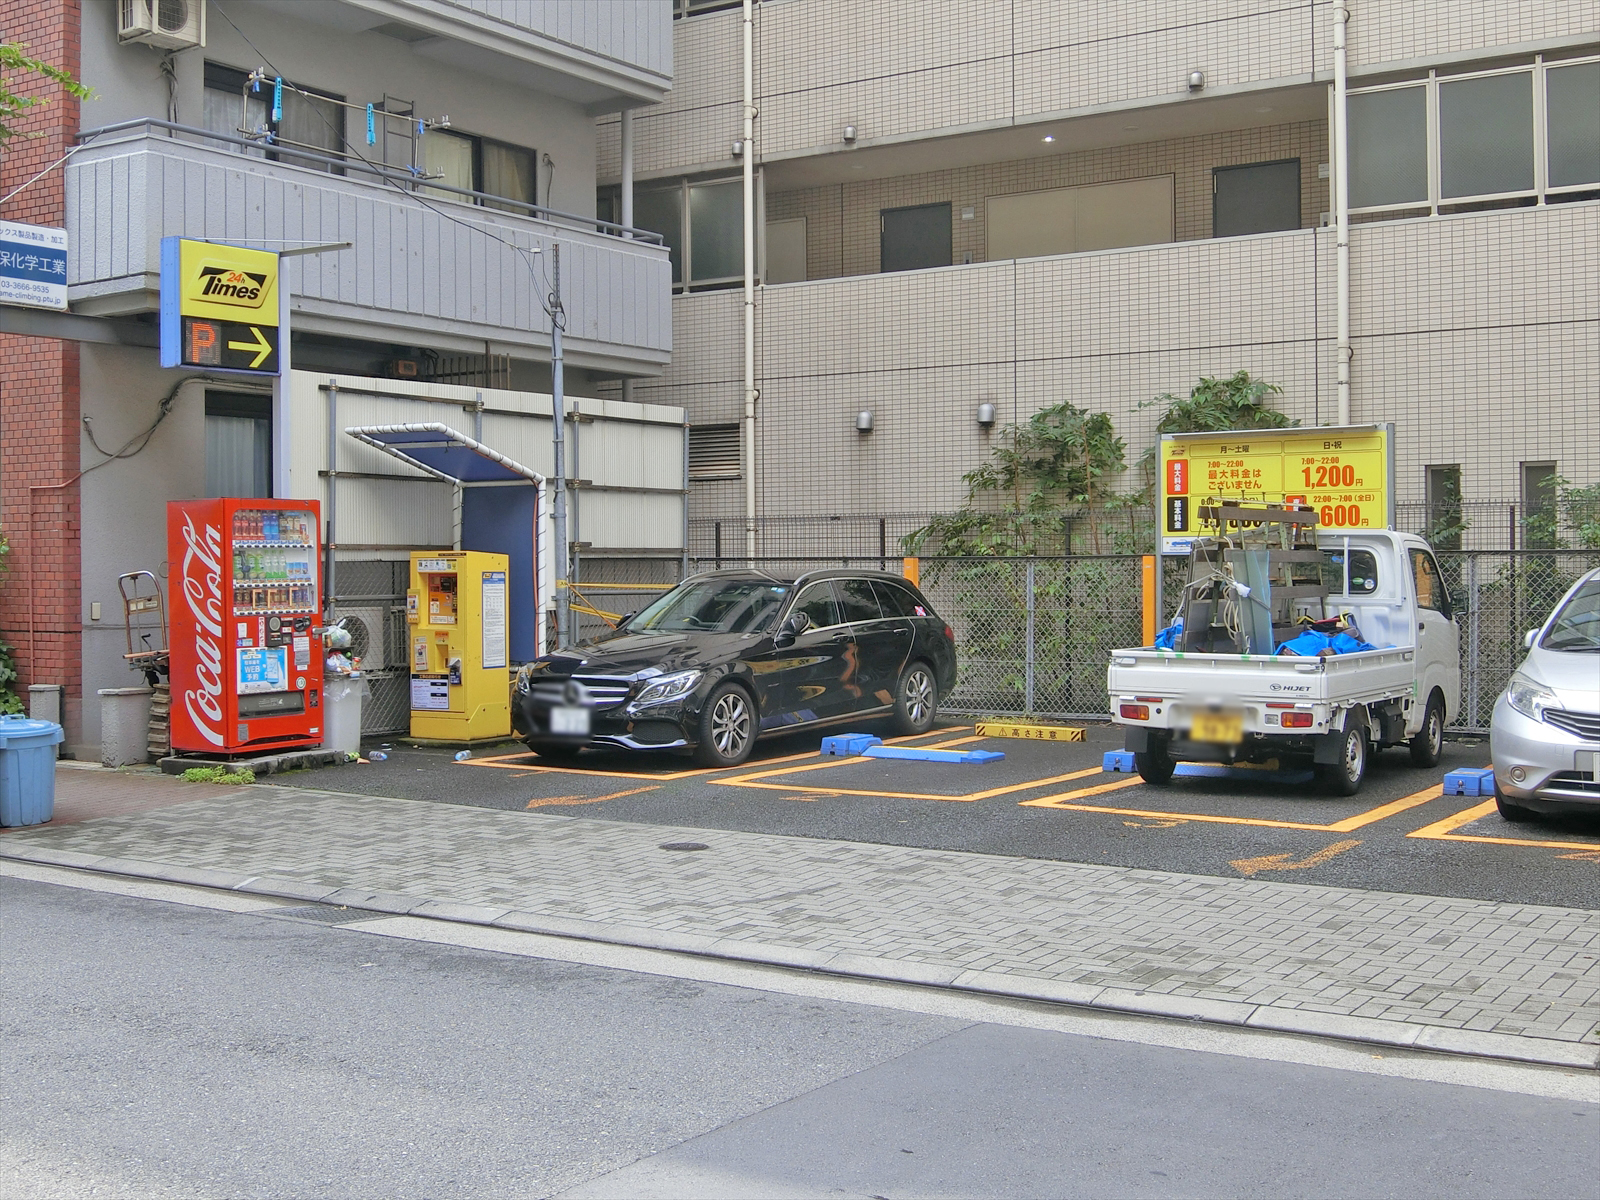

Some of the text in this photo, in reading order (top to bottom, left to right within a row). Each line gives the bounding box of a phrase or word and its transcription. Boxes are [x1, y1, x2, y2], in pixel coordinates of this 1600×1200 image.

[1, 280, 50, 293] 03-3666-9535
[202, 275, 260, 300] Times
[192, 322, 216, 364] P
[1208, 469, 1262, 479] 最大料金は
[1208, 480, 1262, 490] ございません
[1012, 728, 1058, 740] 高さ注意
